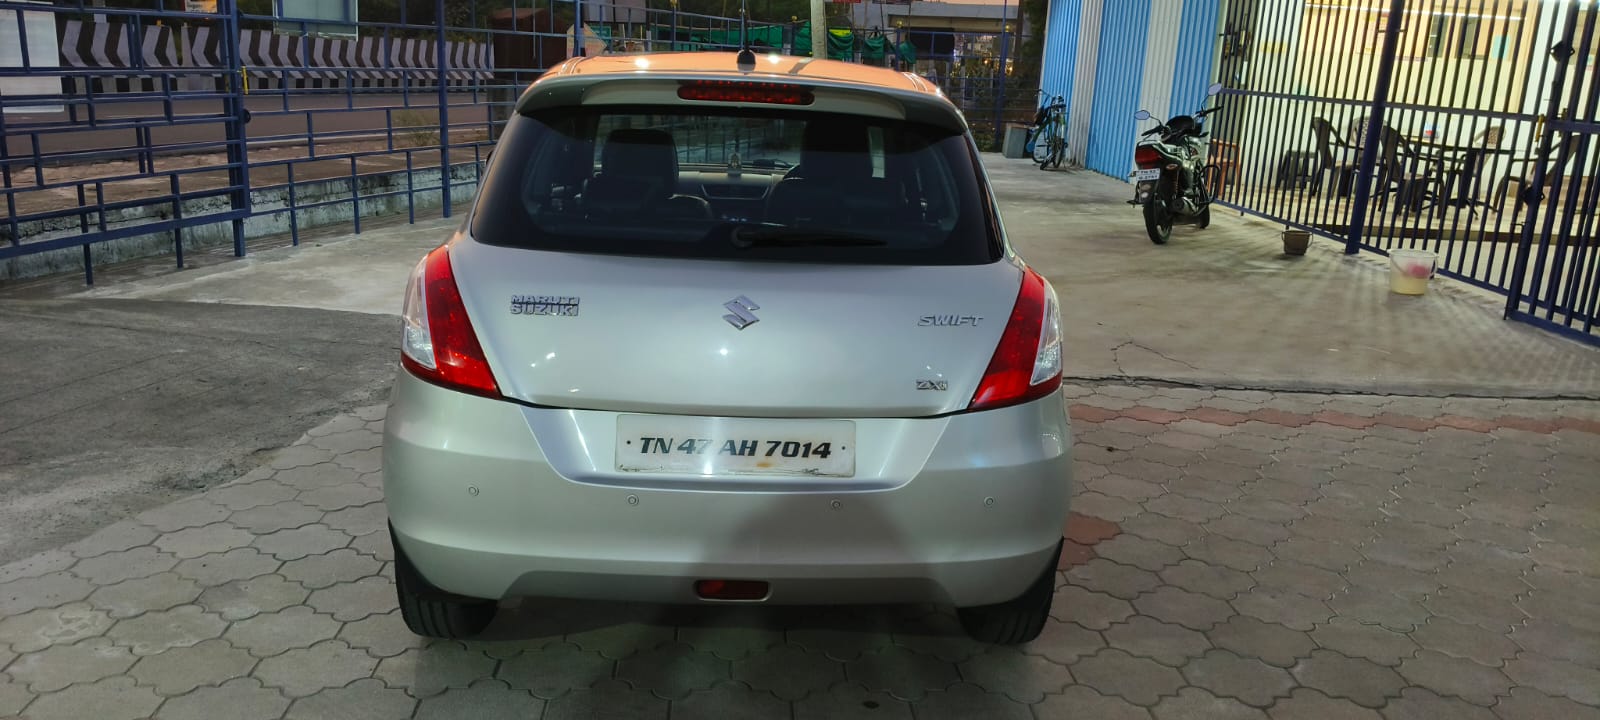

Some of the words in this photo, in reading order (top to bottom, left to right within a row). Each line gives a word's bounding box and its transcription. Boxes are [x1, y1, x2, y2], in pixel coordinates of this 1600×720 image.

[511, 295, 580, 304] MARUTI
[511, 303, 579, 316] SUZUKI
[918, 314, 984, 326] SWIFT
[640, 437, 674, 454] TN
[677, 438, 713, 455] 47
[718, 439, 758, 457] AH
[765, 440, 832, 459] 7014
